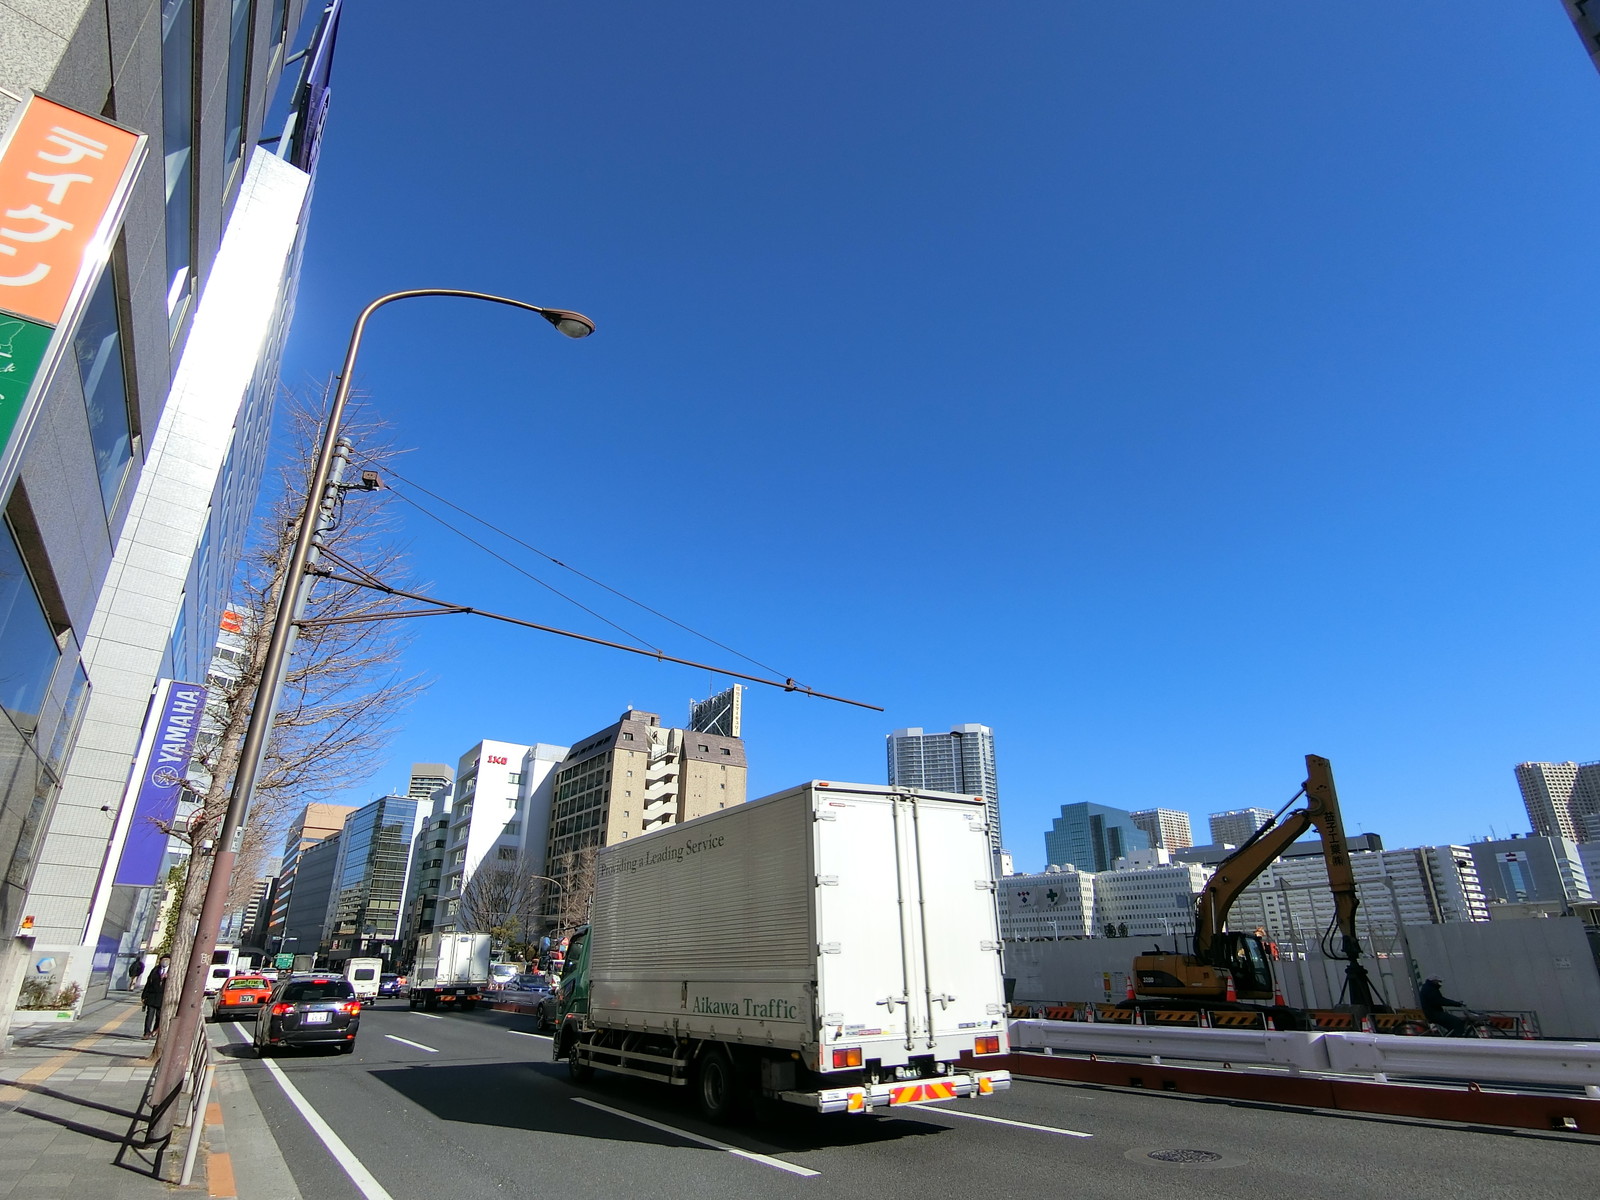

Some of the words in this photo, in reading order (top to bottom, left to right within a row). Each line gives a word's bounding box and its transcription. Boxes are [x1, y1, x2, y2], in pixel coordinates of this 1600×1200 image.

[158, 689, 201, 764] YAMAHA
[600, 858, 638, 876] Providing
[639, 857, 645, 868] a
[645, 845, 685, 867] Leading
[685, 833, 725, 856] Service
[692, 996, 740, 1016] Aikawa
[743, 998, 797, 1020] Traffic
